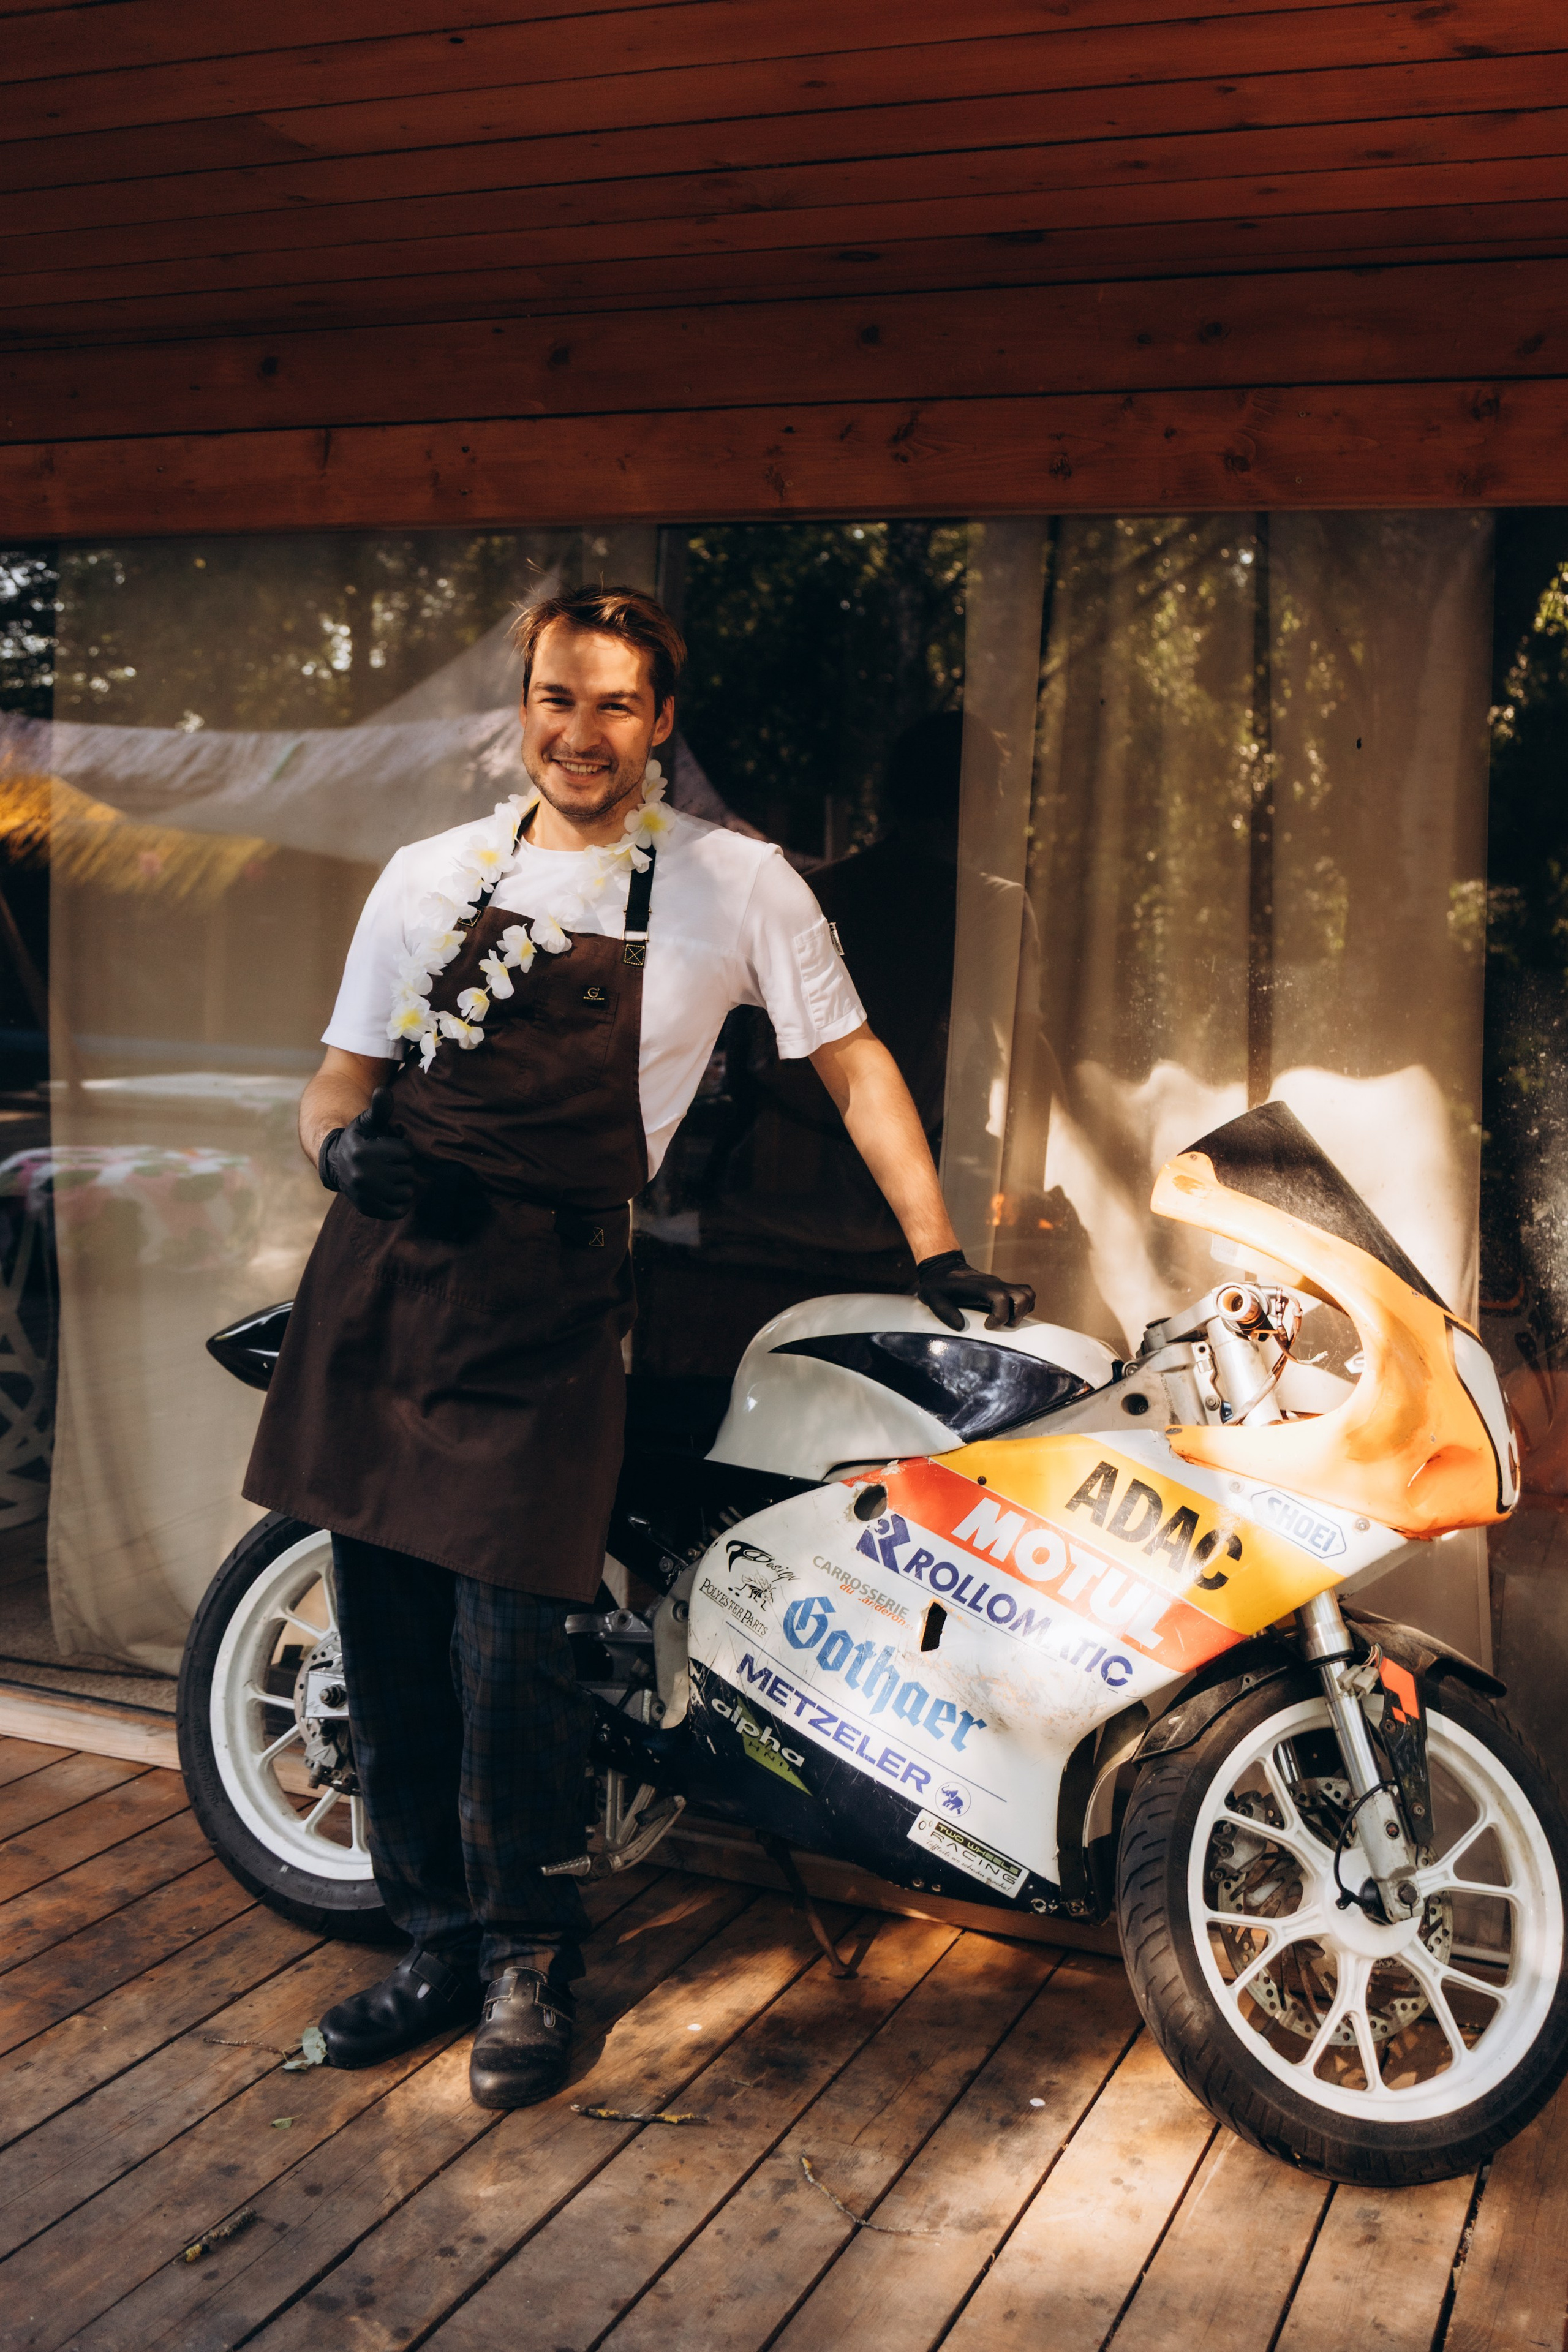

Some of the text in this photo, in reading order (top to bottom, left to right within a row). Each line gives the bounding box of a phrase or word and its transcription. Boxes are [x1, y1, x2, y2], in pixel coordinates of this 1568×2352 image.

[1065, 1461, 1243, 1591] ADAC
[1268, 1496, 1336, 1552] SHOEI
[813, 1556, 910, 1619] CARROSSERIE
[840, 1583, 855, 1595] du
[951, 1497, 1172, 1650] MOTUL
[699, 1578, 769, 1636] POLYESTER PARTS
[783, 1596, 987, 1752] Gothaer
[711, 1698, 805, 1767] alpha
[736, 1653, 932, 1794] METZELER
[930, 1831, 1017, 1885] RACING
[938, 1824, 1019, 1875] TWO WHEELS
